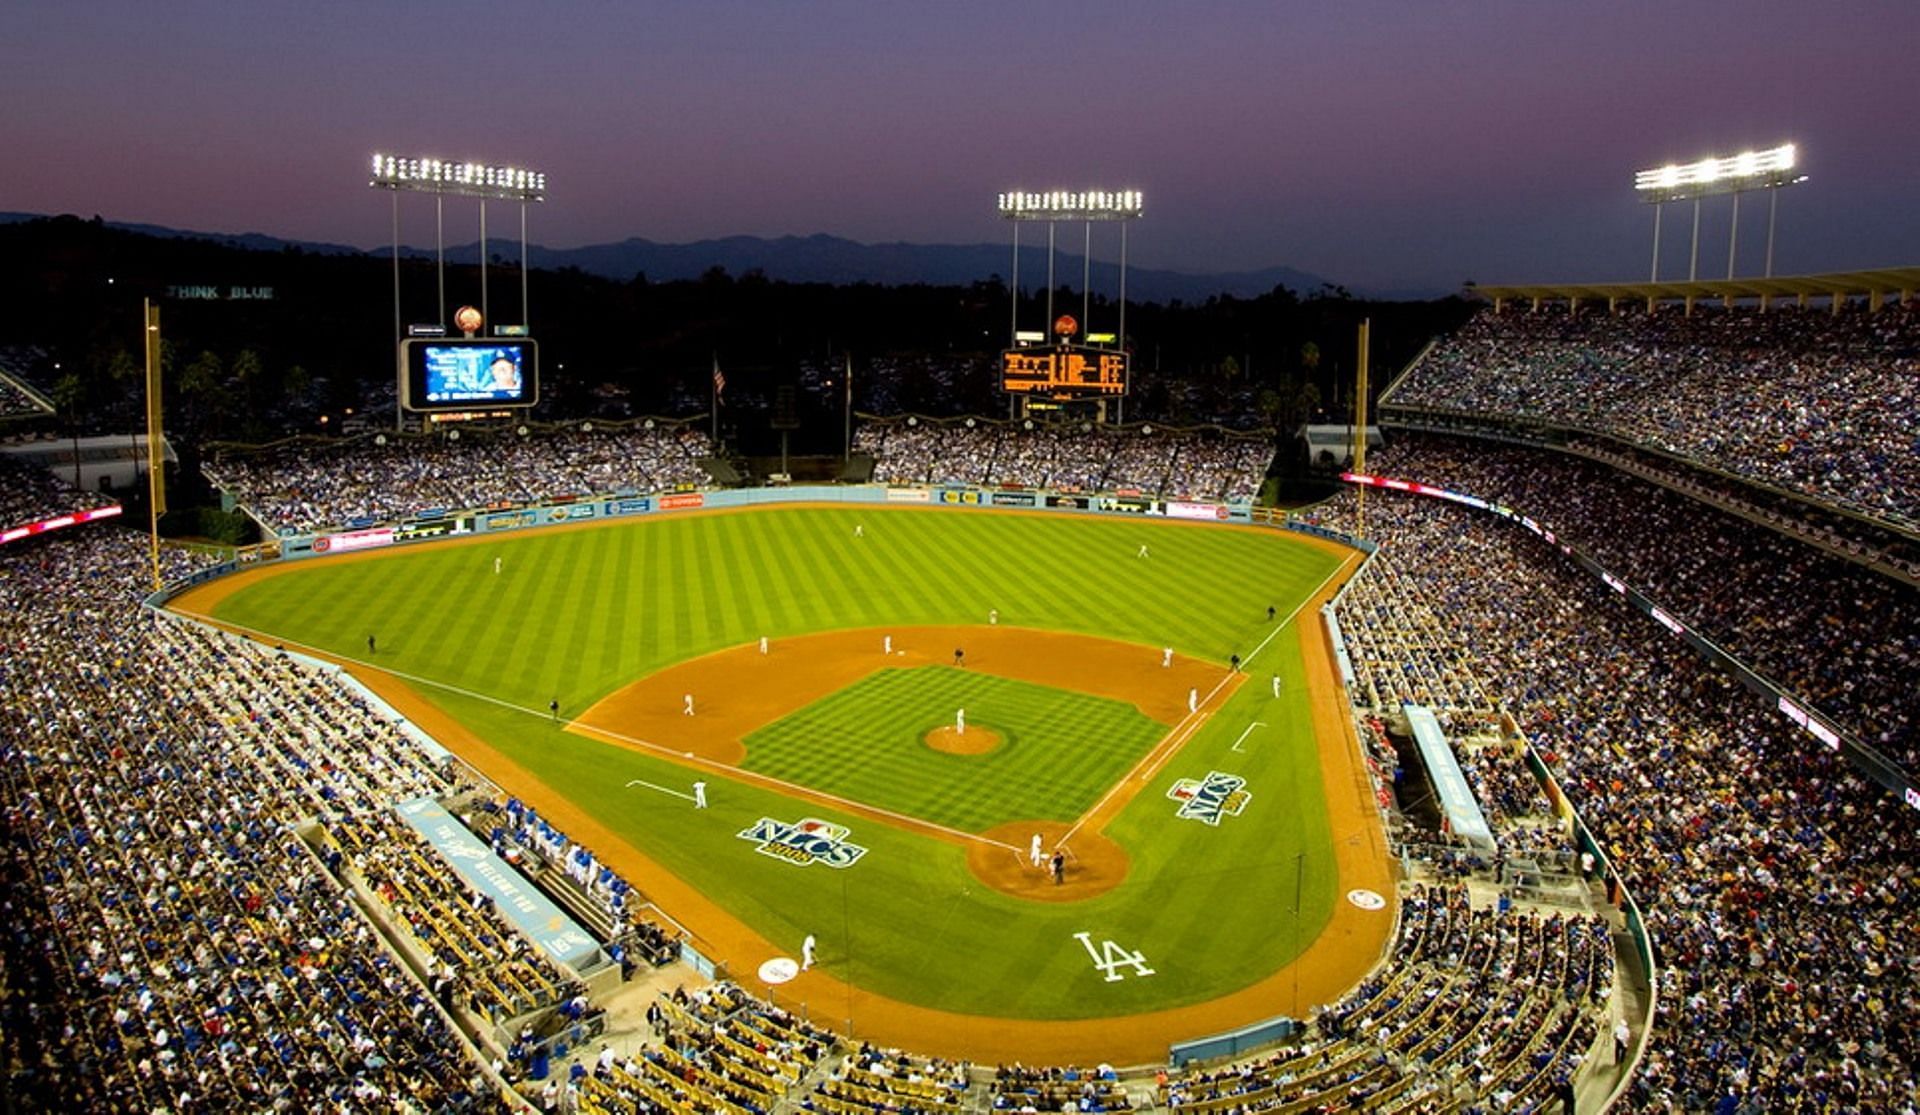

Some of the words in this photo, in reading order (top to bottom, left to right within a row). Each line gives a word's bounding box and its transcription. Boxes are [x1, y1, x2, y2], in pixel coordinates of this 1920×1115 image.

[166, 285, 219, 299] THINK
[230, 286, 274, 299] BLUE
[1180, 770, 1243, 824] NLCS
[742, 820, 863, 866] NLCS
[763, 841, 814, 862] 2008
[1073, 932, 1156, 982] LA
